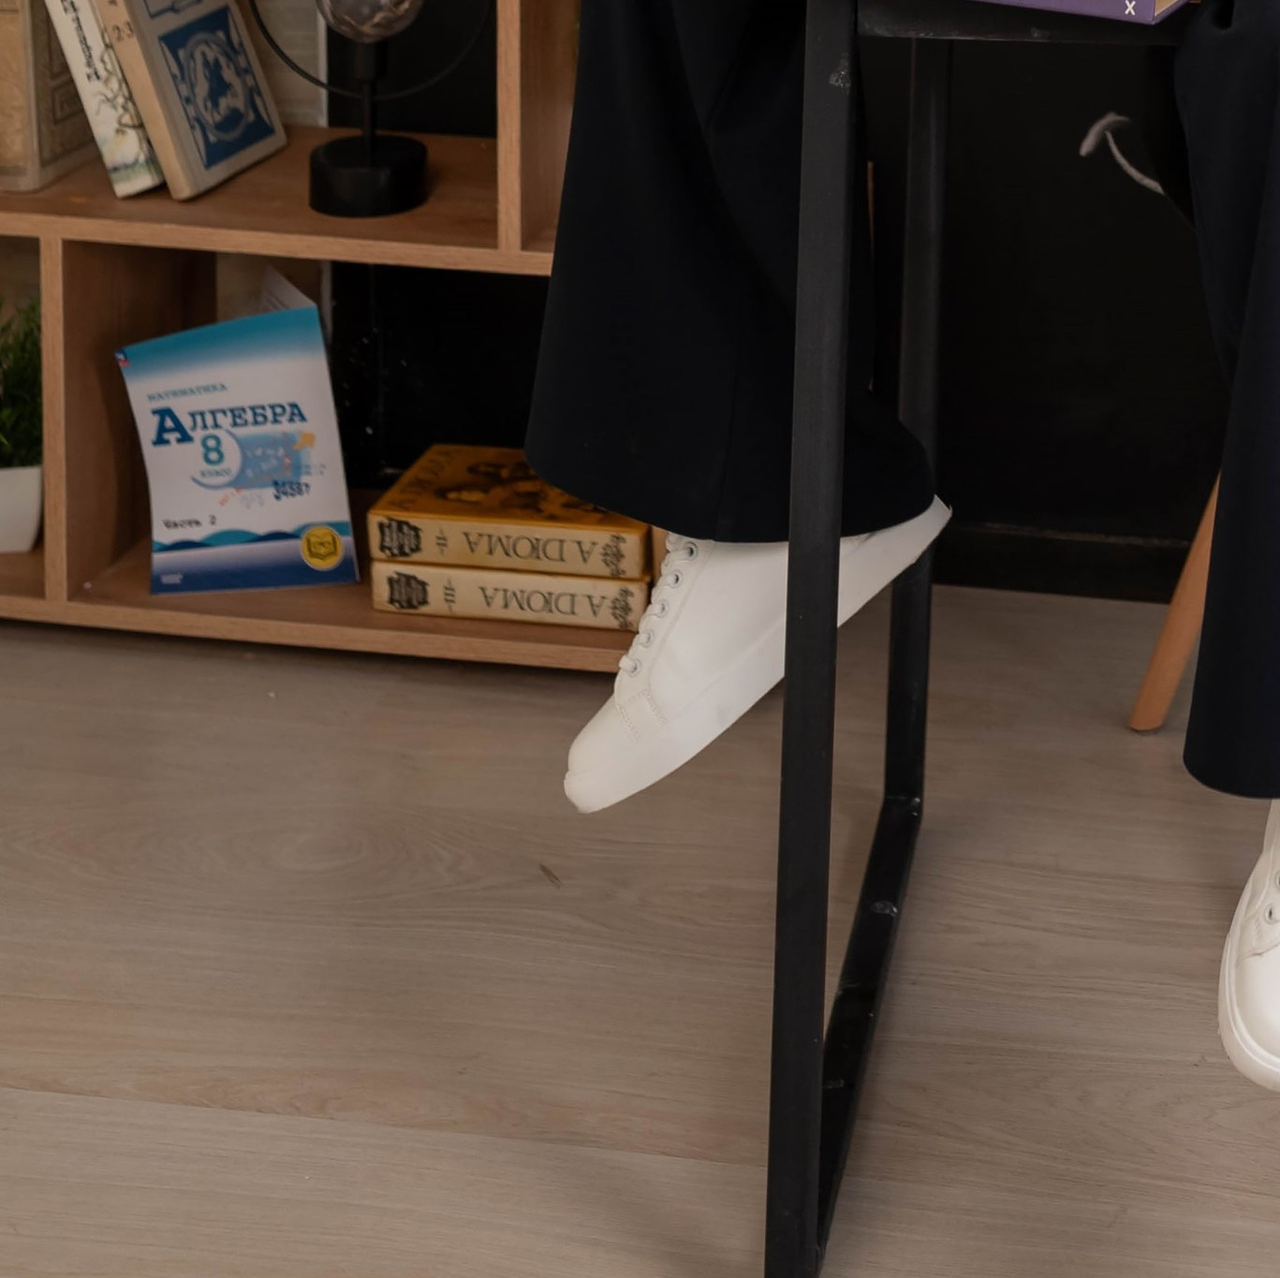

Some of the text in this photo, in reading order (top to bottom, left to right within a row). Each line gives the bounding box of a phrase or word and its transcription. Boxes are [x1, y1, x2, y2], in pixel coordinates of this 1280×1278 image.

[151, 401, 307, 447] АЛГЕБРА
[201, 433, 224, 466] 8
[462, 532, 565, 563] ДЮМА
[478, 586, 577, 616] ДЮМА
